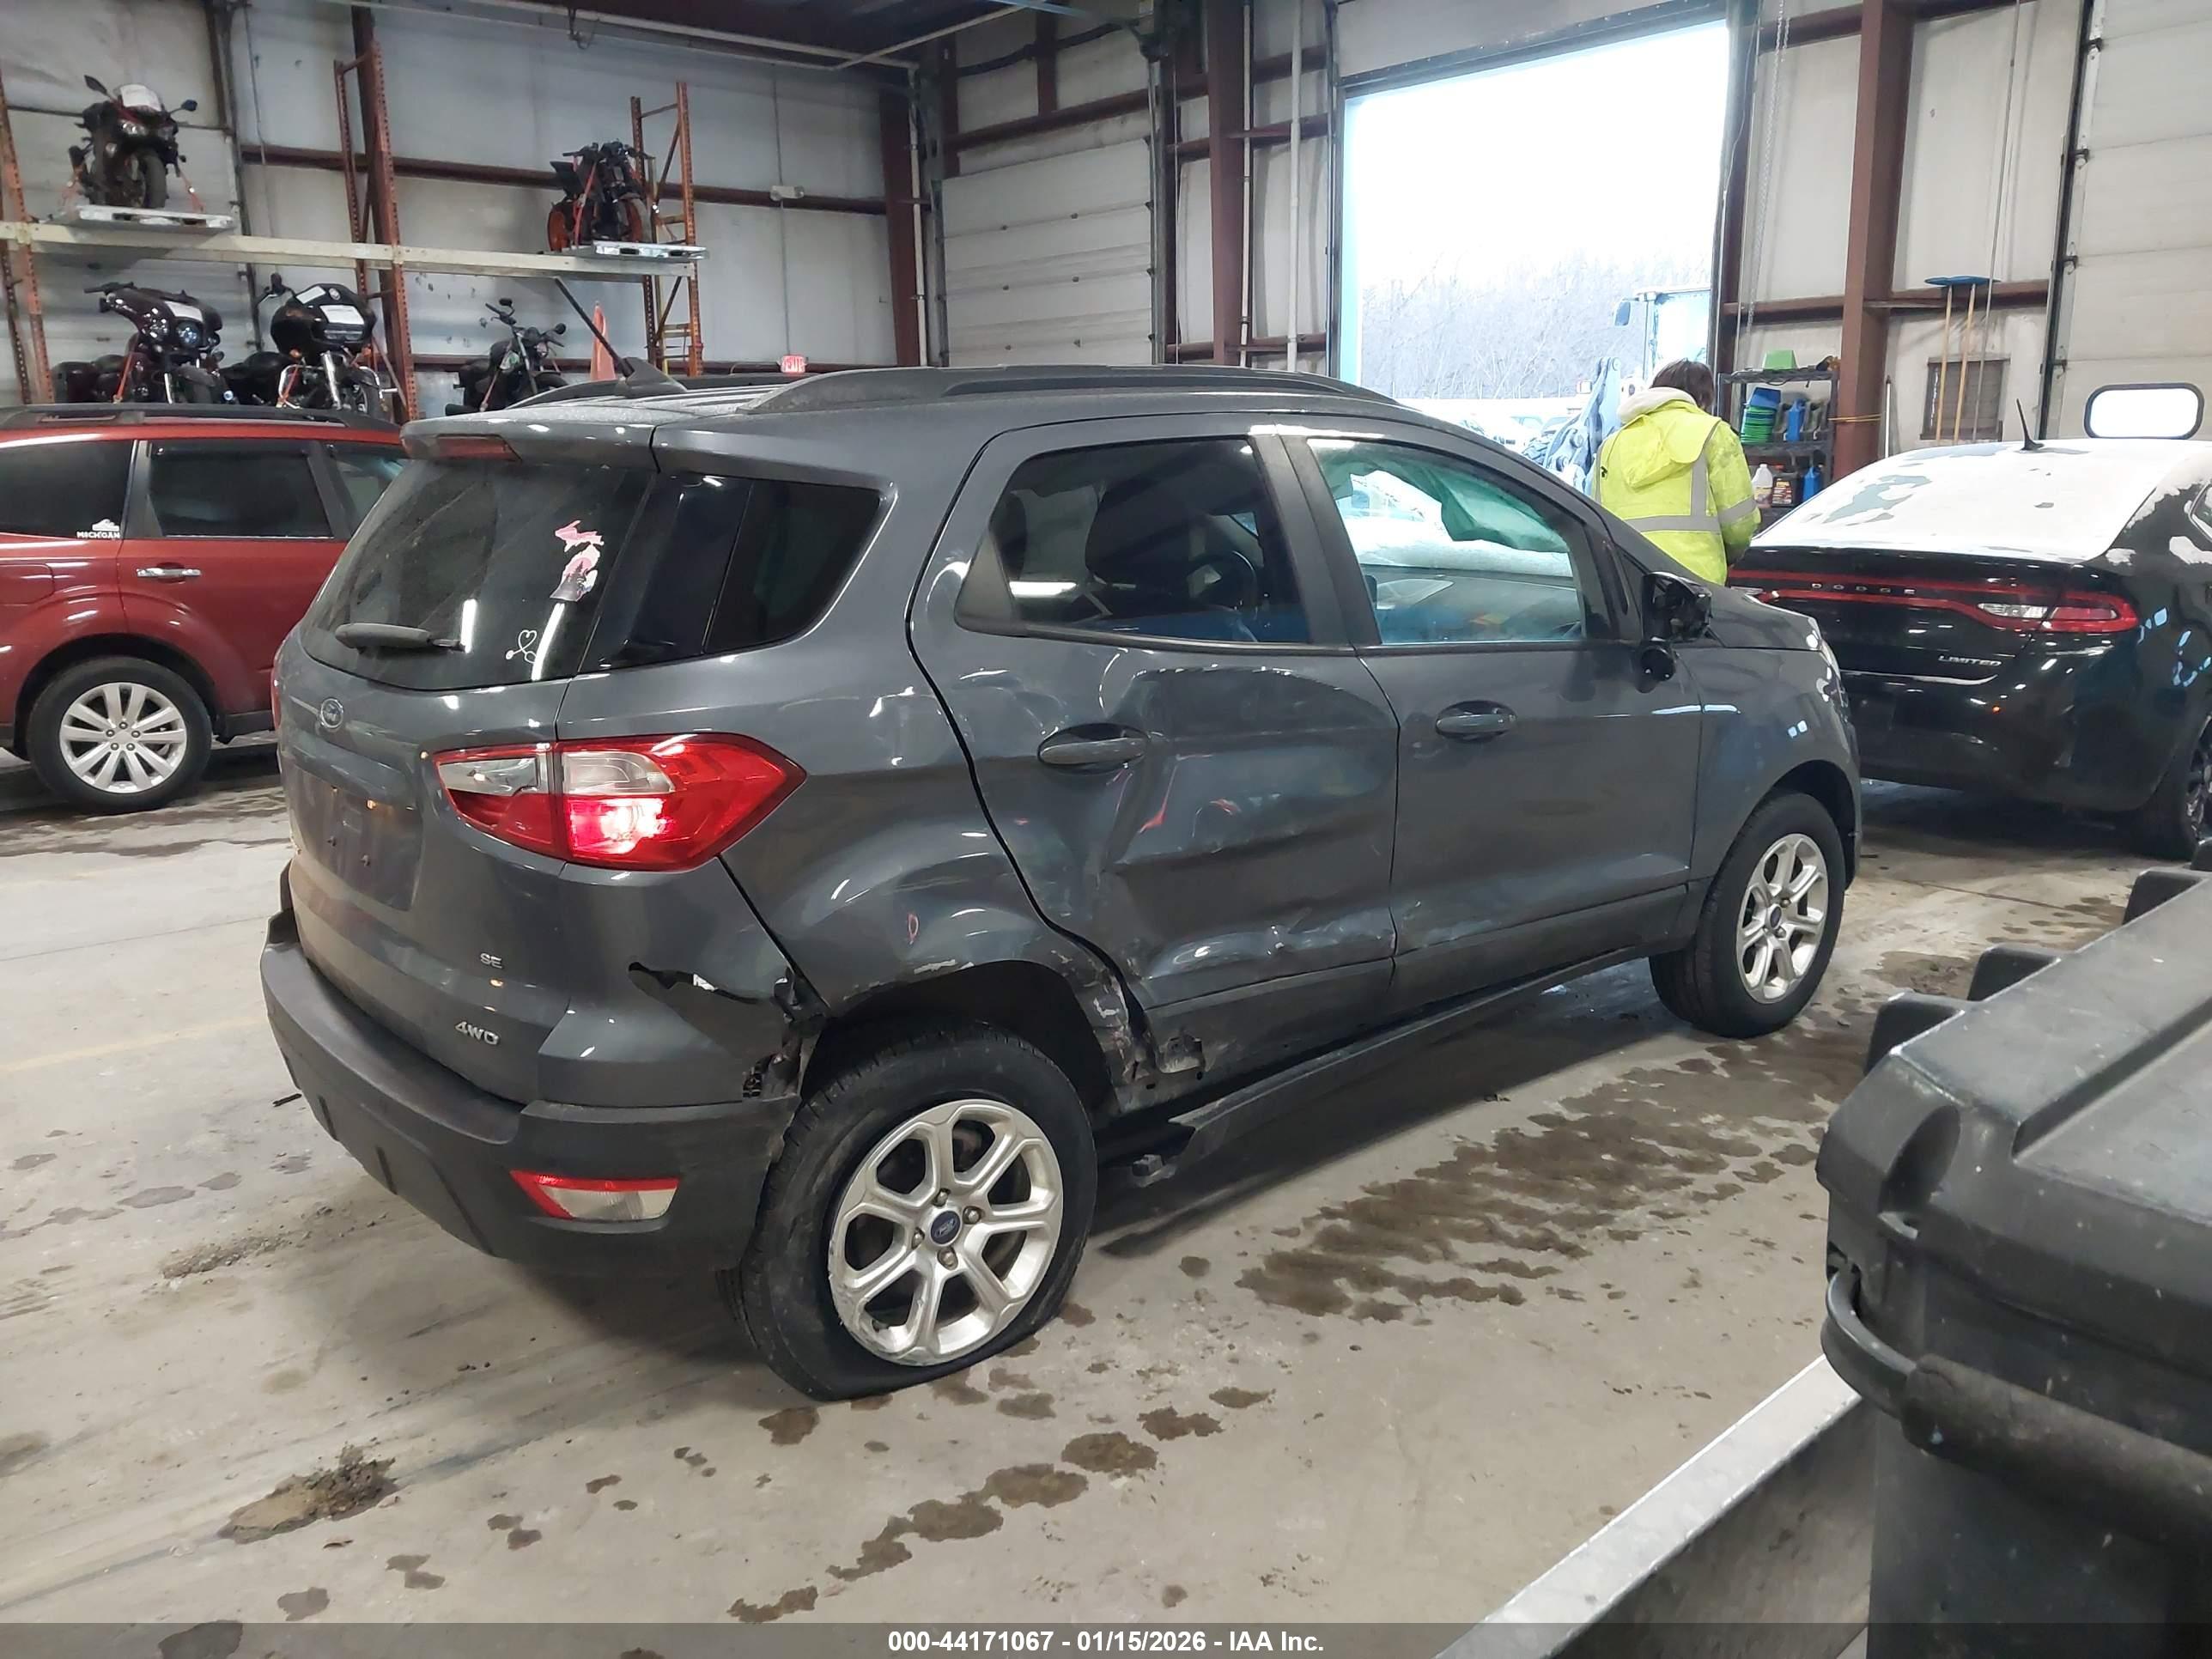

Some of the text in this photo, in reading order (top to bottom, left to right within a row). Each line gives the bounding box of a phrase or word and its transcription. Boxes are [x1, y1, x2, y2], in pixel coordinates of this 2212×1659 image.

[1811, 583, 1916, 595] DODGE
[1938, 655, 2002, 666] LIMITED
[480, 952, 503, 969] SE
[455, 1021, 499, 1045] 4WD
